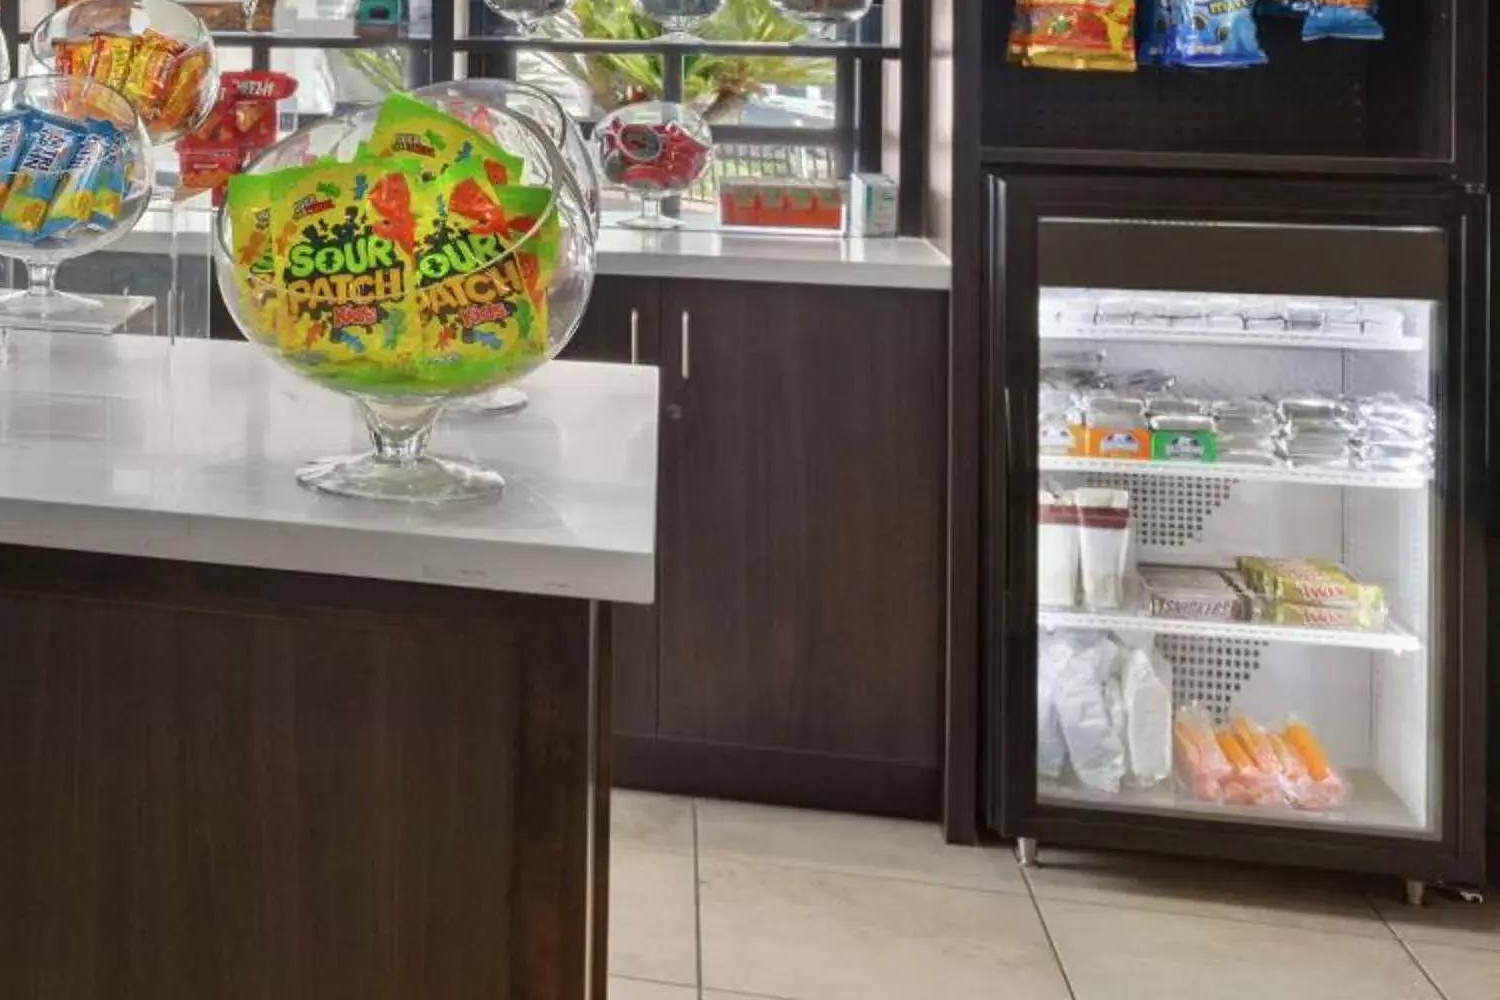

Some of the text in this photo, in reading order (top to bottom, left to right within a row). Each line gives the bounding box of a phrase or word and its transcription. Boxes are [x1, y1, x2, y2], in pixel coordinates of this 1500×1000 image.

[288, 236, 394, 278] SOUR
[418, 231, 501, 279] OUR
[287, 266, 403, 316] PATCH
